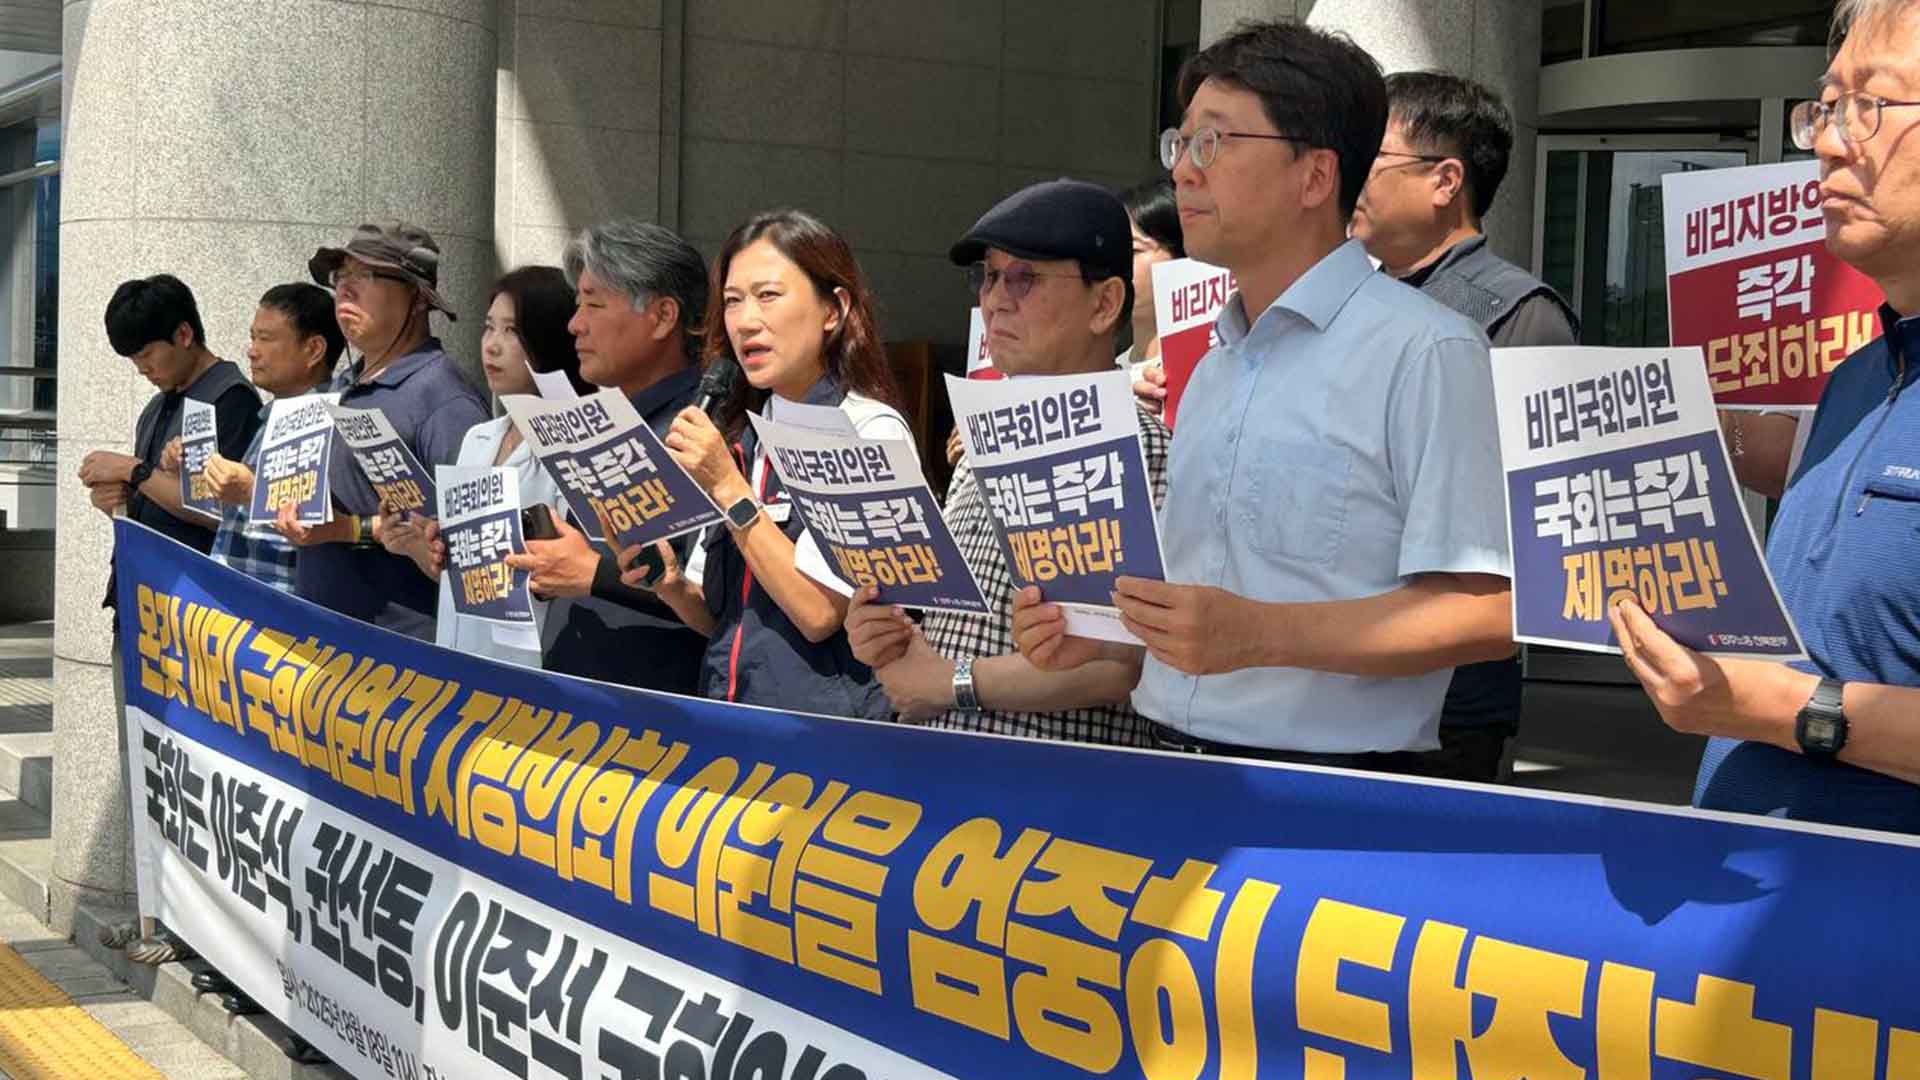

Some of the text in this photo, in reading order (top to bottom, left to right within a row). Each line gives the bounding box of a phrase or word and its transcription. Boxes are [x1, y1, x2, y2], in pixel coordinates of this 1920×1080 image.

[1737, 254, 1816, 321] 즉각
[966, 384, 1102, 456] 비리국회의원
[1525, 358, 1679, 450] 비리국회의원
[265, 470, 318, 513] 제명하라!
[444, 472, 504, 519] 비리국회의원
[589, 437, 658, 489] 즉각
[774, 445, 896, 485] 비리국회의원
[1051, 451, 1125, 517] 즉각
[1634, 451, 1716, 534] 즉각
[480, 518, 514, 560] 즉각
[861, 496, 932, 543] 즉각
[1008, 518, 1124, 583] 제명하라!
[829, 544, 943, 589] 제명하라!
[1561, 537, 1728, 622] 제명하라!
[137, 583, 1920, 1080] 온갖 비리 국회의원과 지방의회 의원을 엄중히 단죄
[143, 728, 209, 872] 국회는
[210, 771, 304, 944] 이춘석,
[434, 890, 609, 1080] 이준석
[598, 965, 867, 1080] 국회
